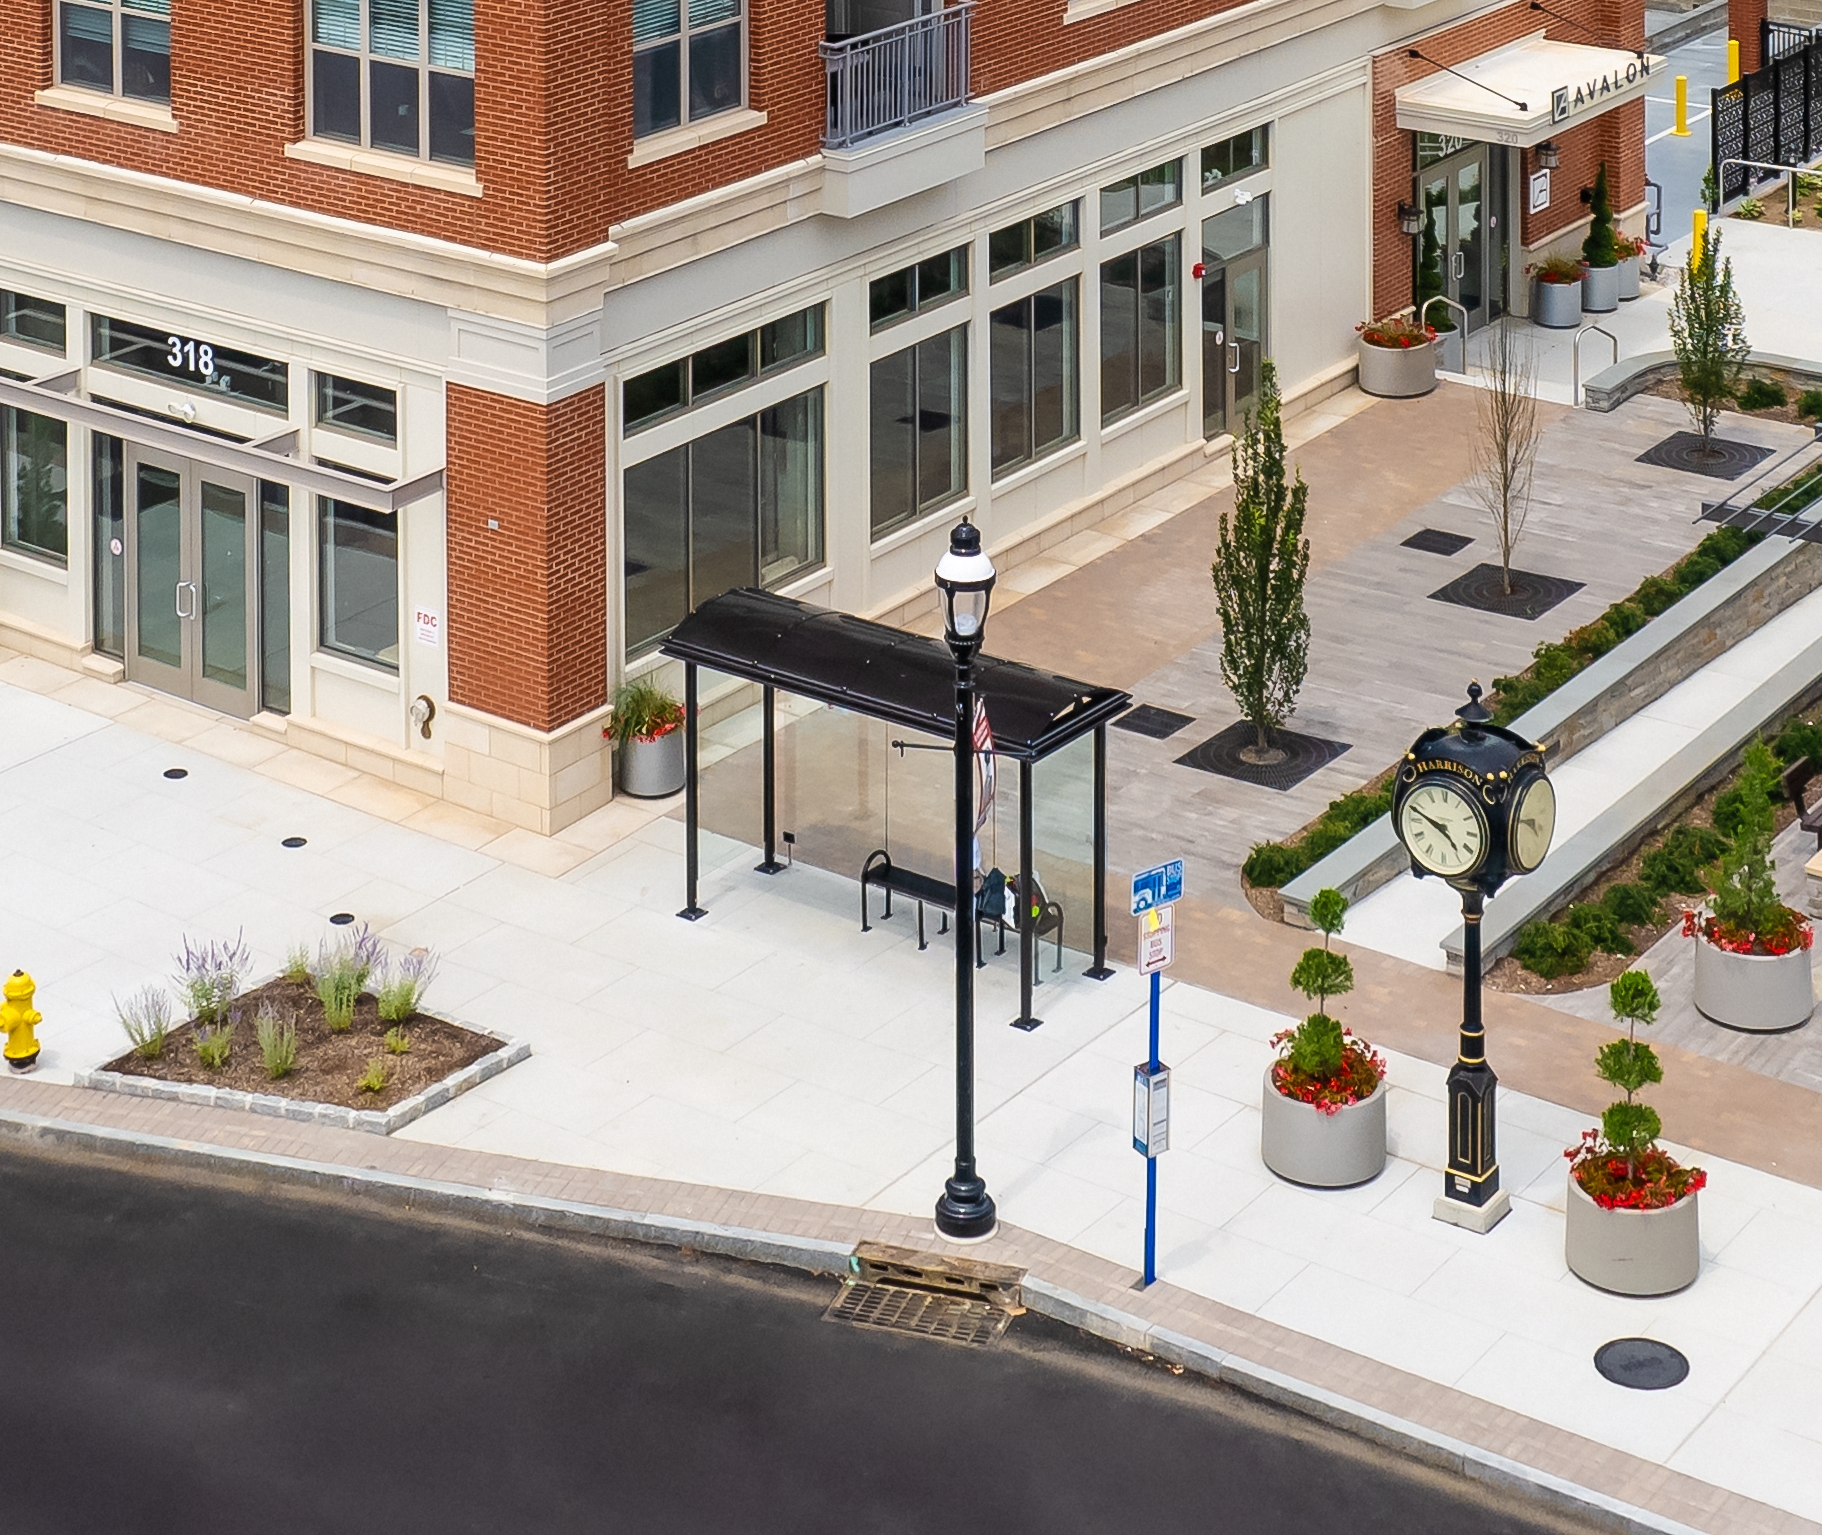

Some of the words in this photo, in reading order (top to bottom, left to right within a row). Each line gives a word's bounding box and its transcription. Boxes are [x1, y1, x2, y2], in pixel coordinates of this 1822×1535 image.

[1574, 56, 1650, 108] AVALON
[1438, 134, 1463, 158] 320
[1496, 131, 1518, 145] 320
[166, 336, 214, 376] 318
[416, 611, 438, 628] FDC
[1417, 759, 1483, 786] HARRISON
[1166, 861, 1182, 877] BUS
